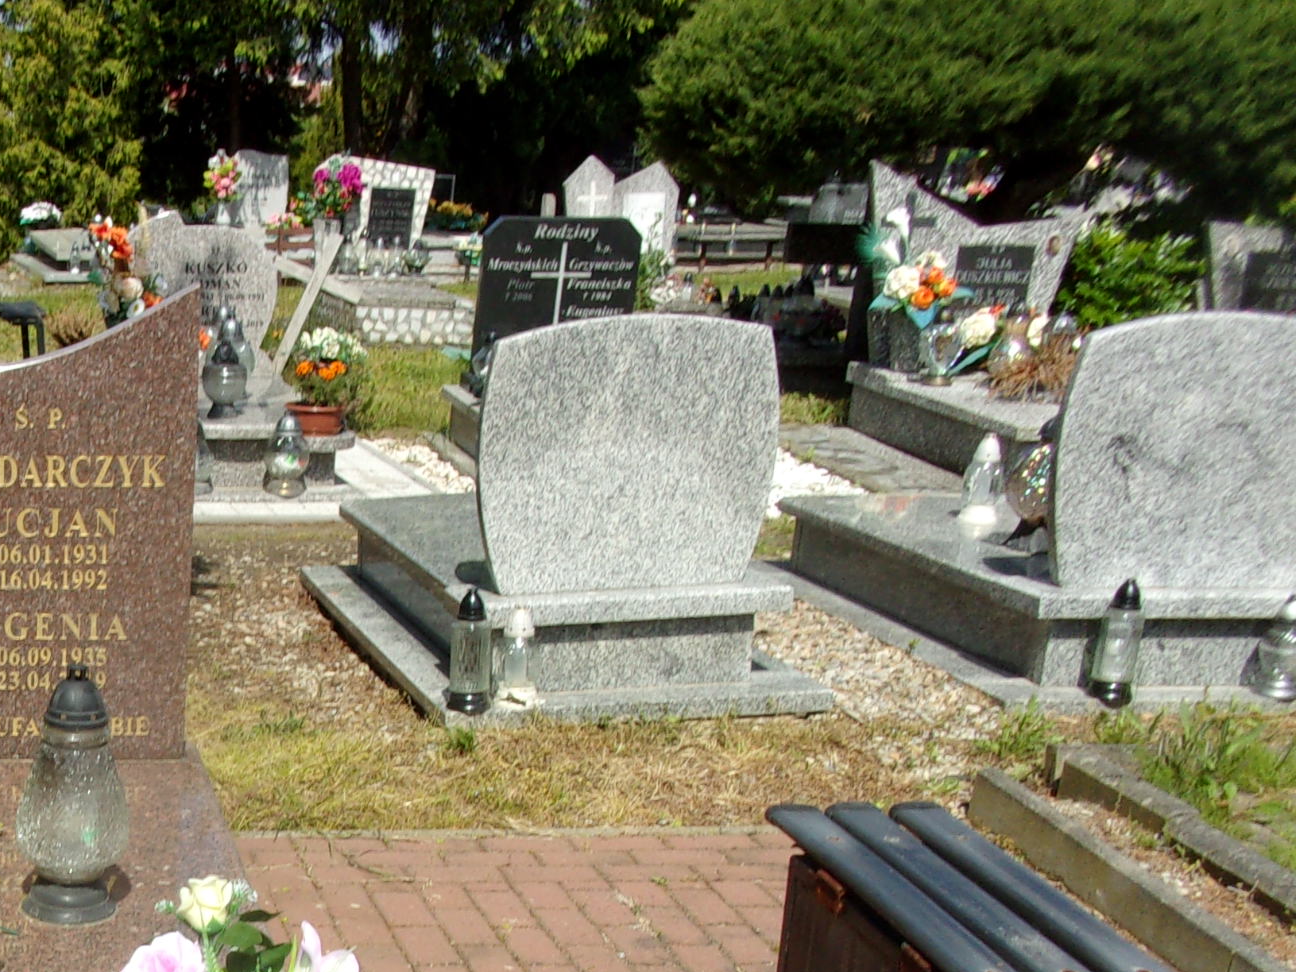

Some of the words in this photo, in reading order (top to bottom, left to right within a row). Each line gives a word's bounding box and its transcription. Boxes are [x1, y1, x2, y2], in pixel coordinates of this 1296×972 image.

[535, 222, 599, 241] Rodziny
[191, 278, 241, 290] OMAN
[47, 407, 67, 429] P.
